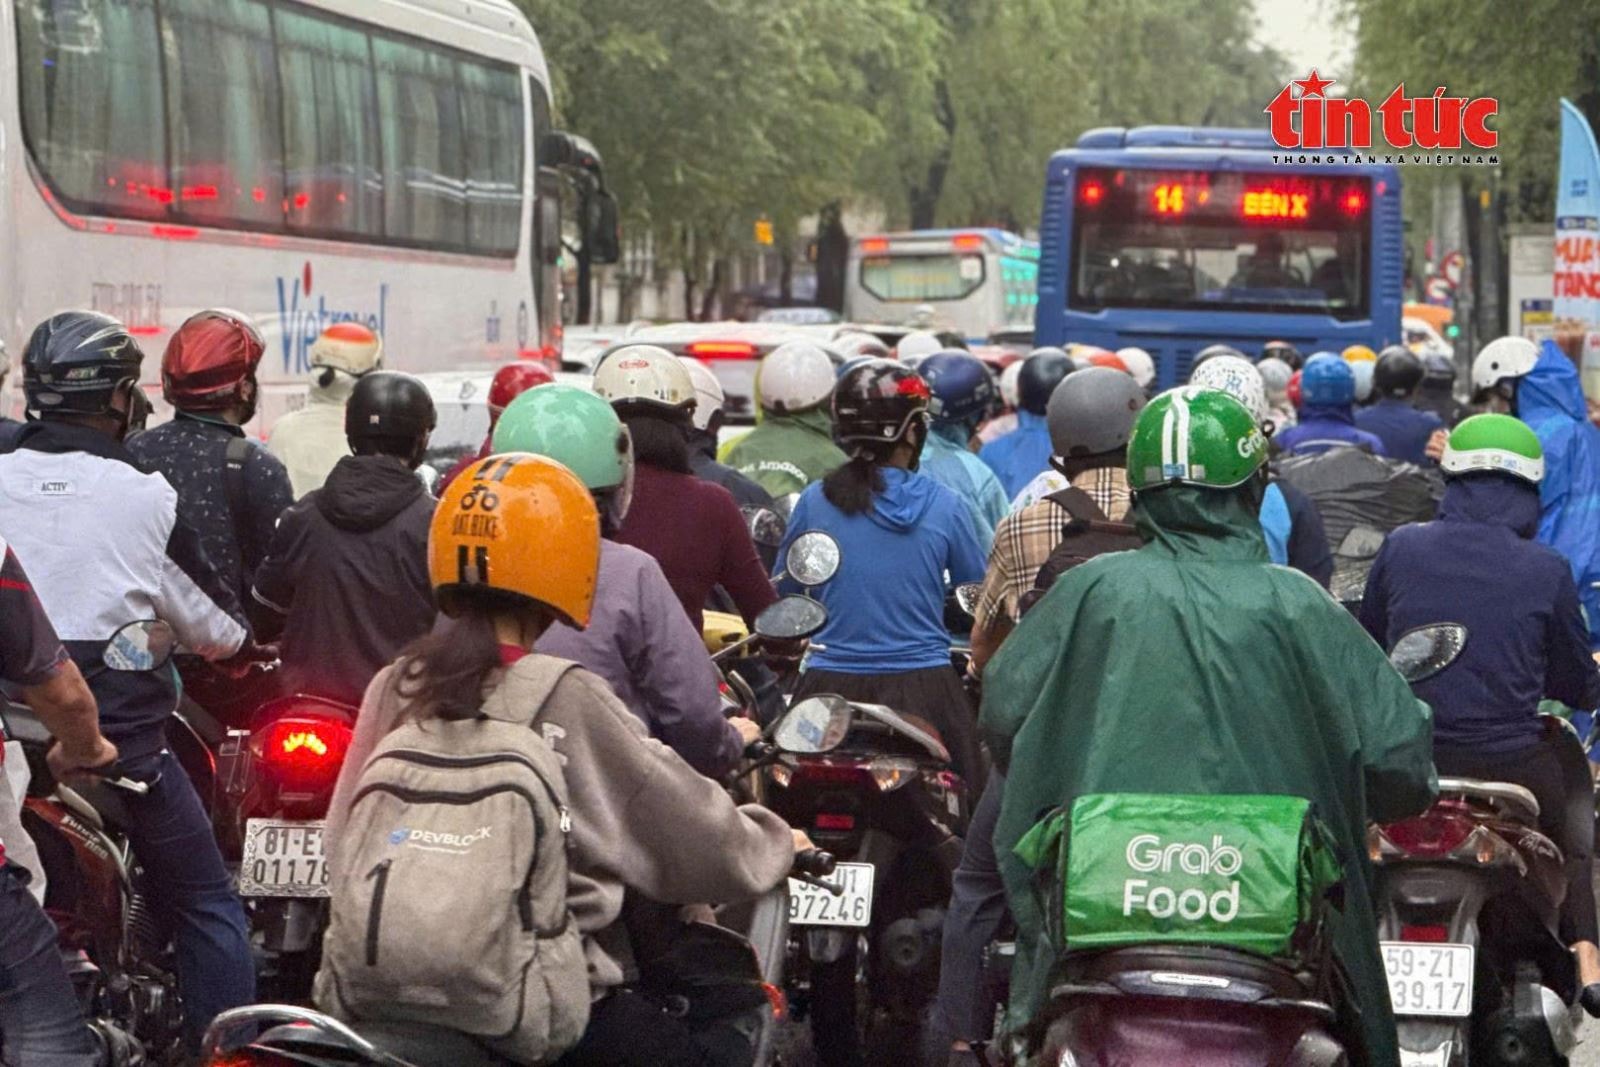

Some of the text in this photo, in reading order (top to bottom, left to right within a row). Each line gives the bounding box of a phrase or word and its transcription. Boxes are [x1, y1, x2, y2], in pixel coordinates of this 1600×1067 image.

[1155, 184, 1183, 212] 14
[41, 482, 67, 492] ACTIV
[1126, 834, 1242, 876] Grab
[1123, 879, 1240, 922] Food
[1386, 948, 1454, 978] 59-Z1
